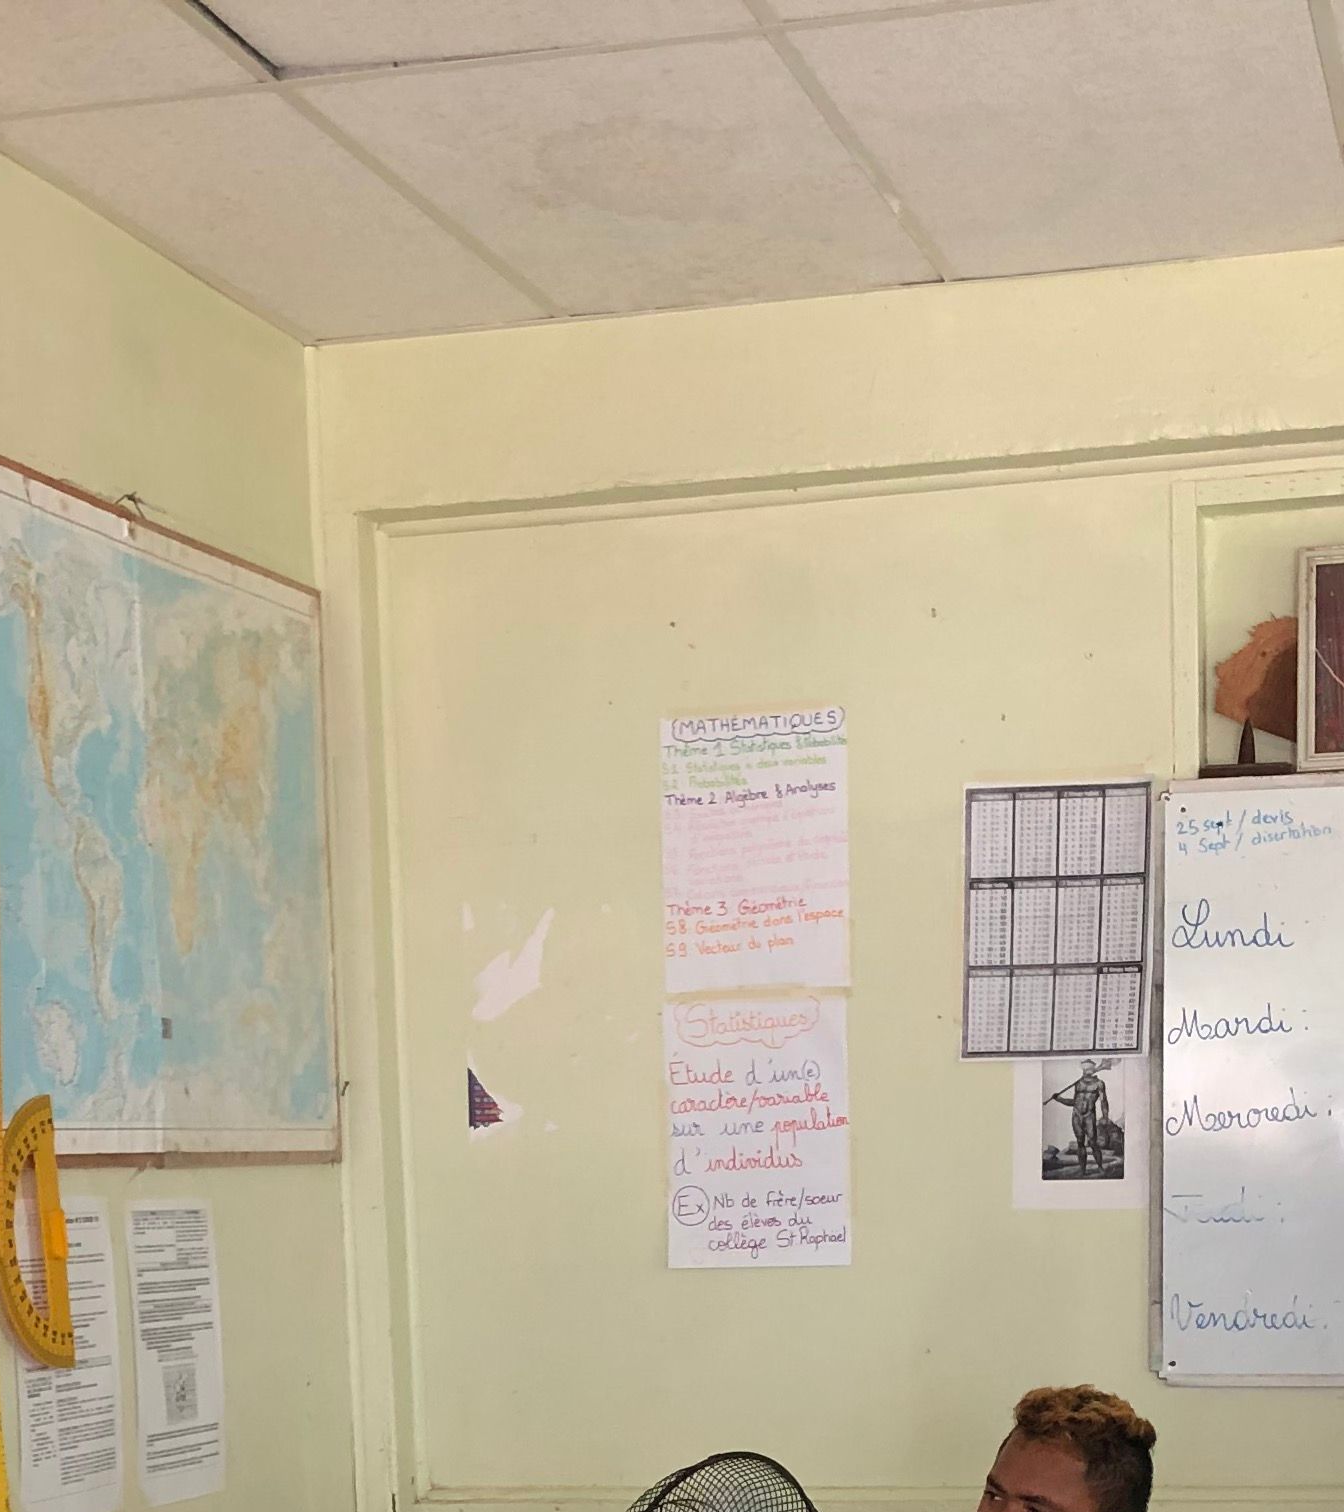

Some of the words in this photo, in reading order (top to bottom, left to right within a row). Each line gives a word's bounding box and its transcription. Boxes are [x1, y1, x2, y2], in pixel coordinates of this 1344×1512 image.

[678, 709, 838, 736] MATHÉMATIQUES
[664, 792, 704, 806] Thème
[707, 791, 717, 805] 2
[786, 778, 836, 799] Analyses
[1176, 820, 1199, 835] 25
[1251, 810, 1294, 825] devis
[666, 900, 712, 917] Thème
[717, 901, 728, 916] 3
[738, 896, 806, 916] Géométrie
[1172, 898, 1295, 949] Lundi
[768, 934, 794, 953] plan
[1167, 1002, 1292, 1045] Mardi
[669, 1052, 734, 1086] Étude
[671, 1121, 704, 1137] sur
[720, 1119, 764, 1136] une
[771, 1106, 849, 1150] population
[677, 1194, 704, 1217] Ex
[714, 1193, 734, 1209] Nb
[741, 1192, 757, 1208] de
[708, 1216, 732, 1231] des
[741, 1212, 782, 1231] élèves
[788, 1212, 813, 1226] du
[708, 1232, 767, 1259] collège
[776, 1228, 794, 1248] St
